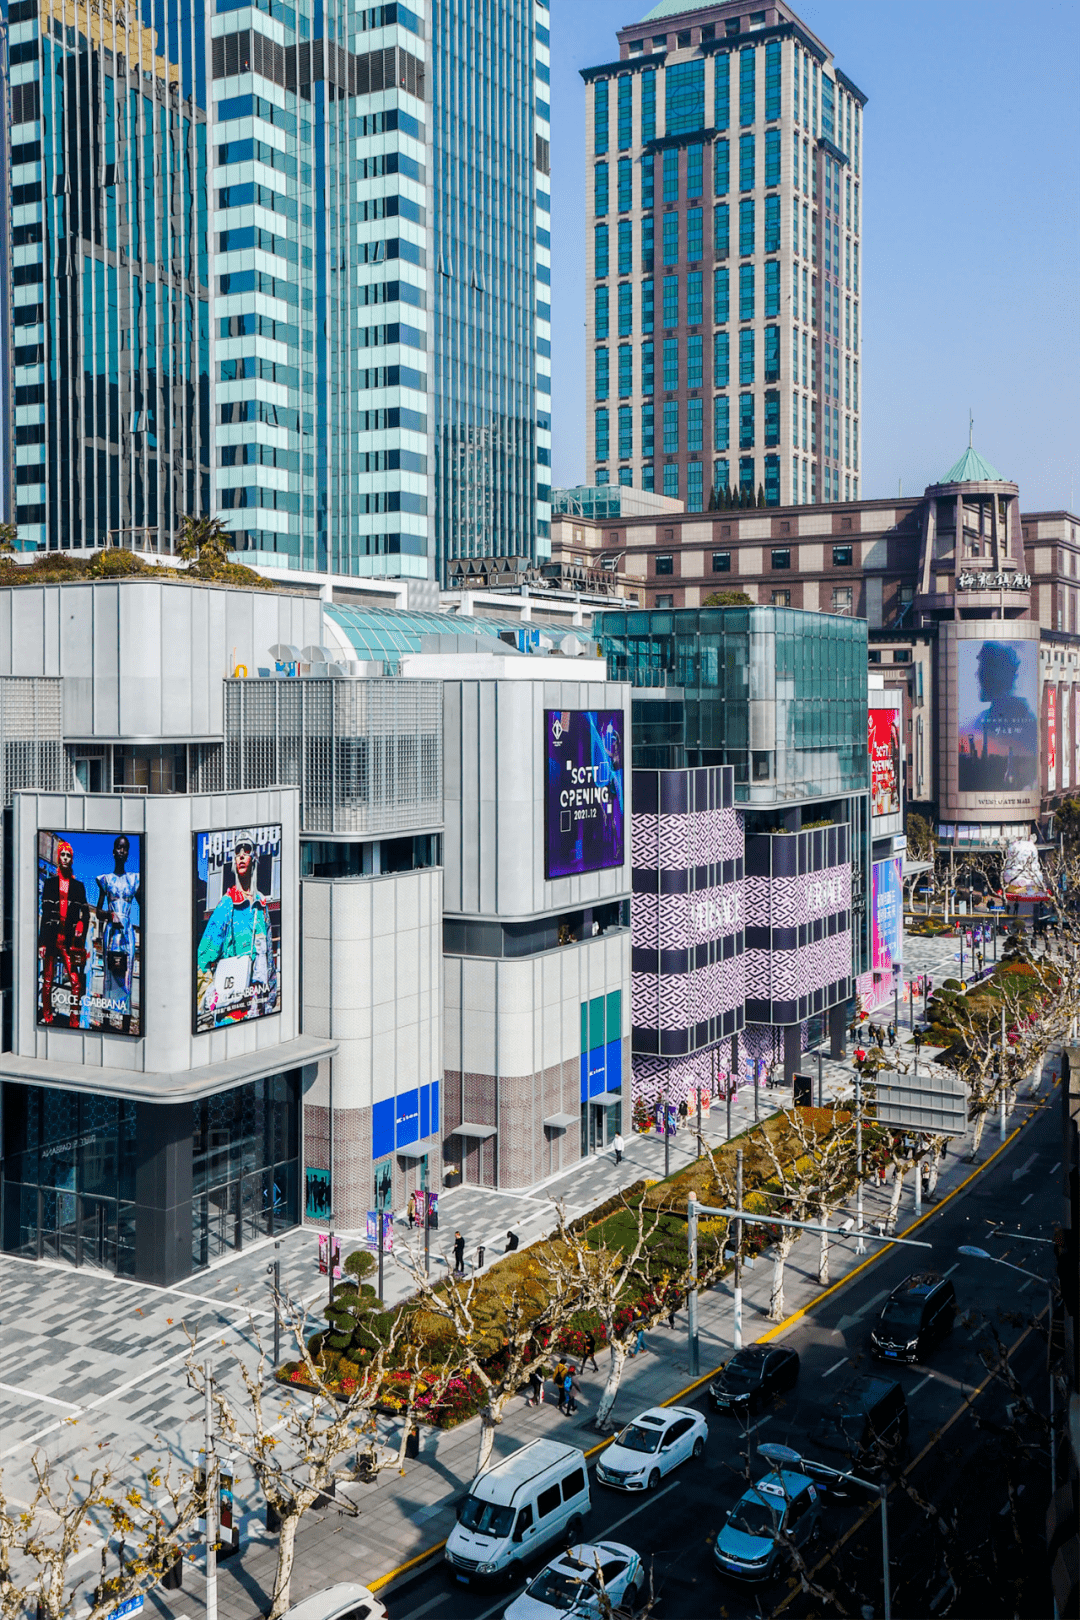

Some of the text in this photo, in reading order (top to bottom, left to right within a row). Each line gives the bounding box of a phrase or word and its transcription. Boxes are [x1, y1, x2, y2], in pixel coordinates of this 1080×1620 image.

[571, 766, 599, 784] SOFT
[560, 787, 609, 807] OPENING
[574, 808, 597, 820] 2021.12
